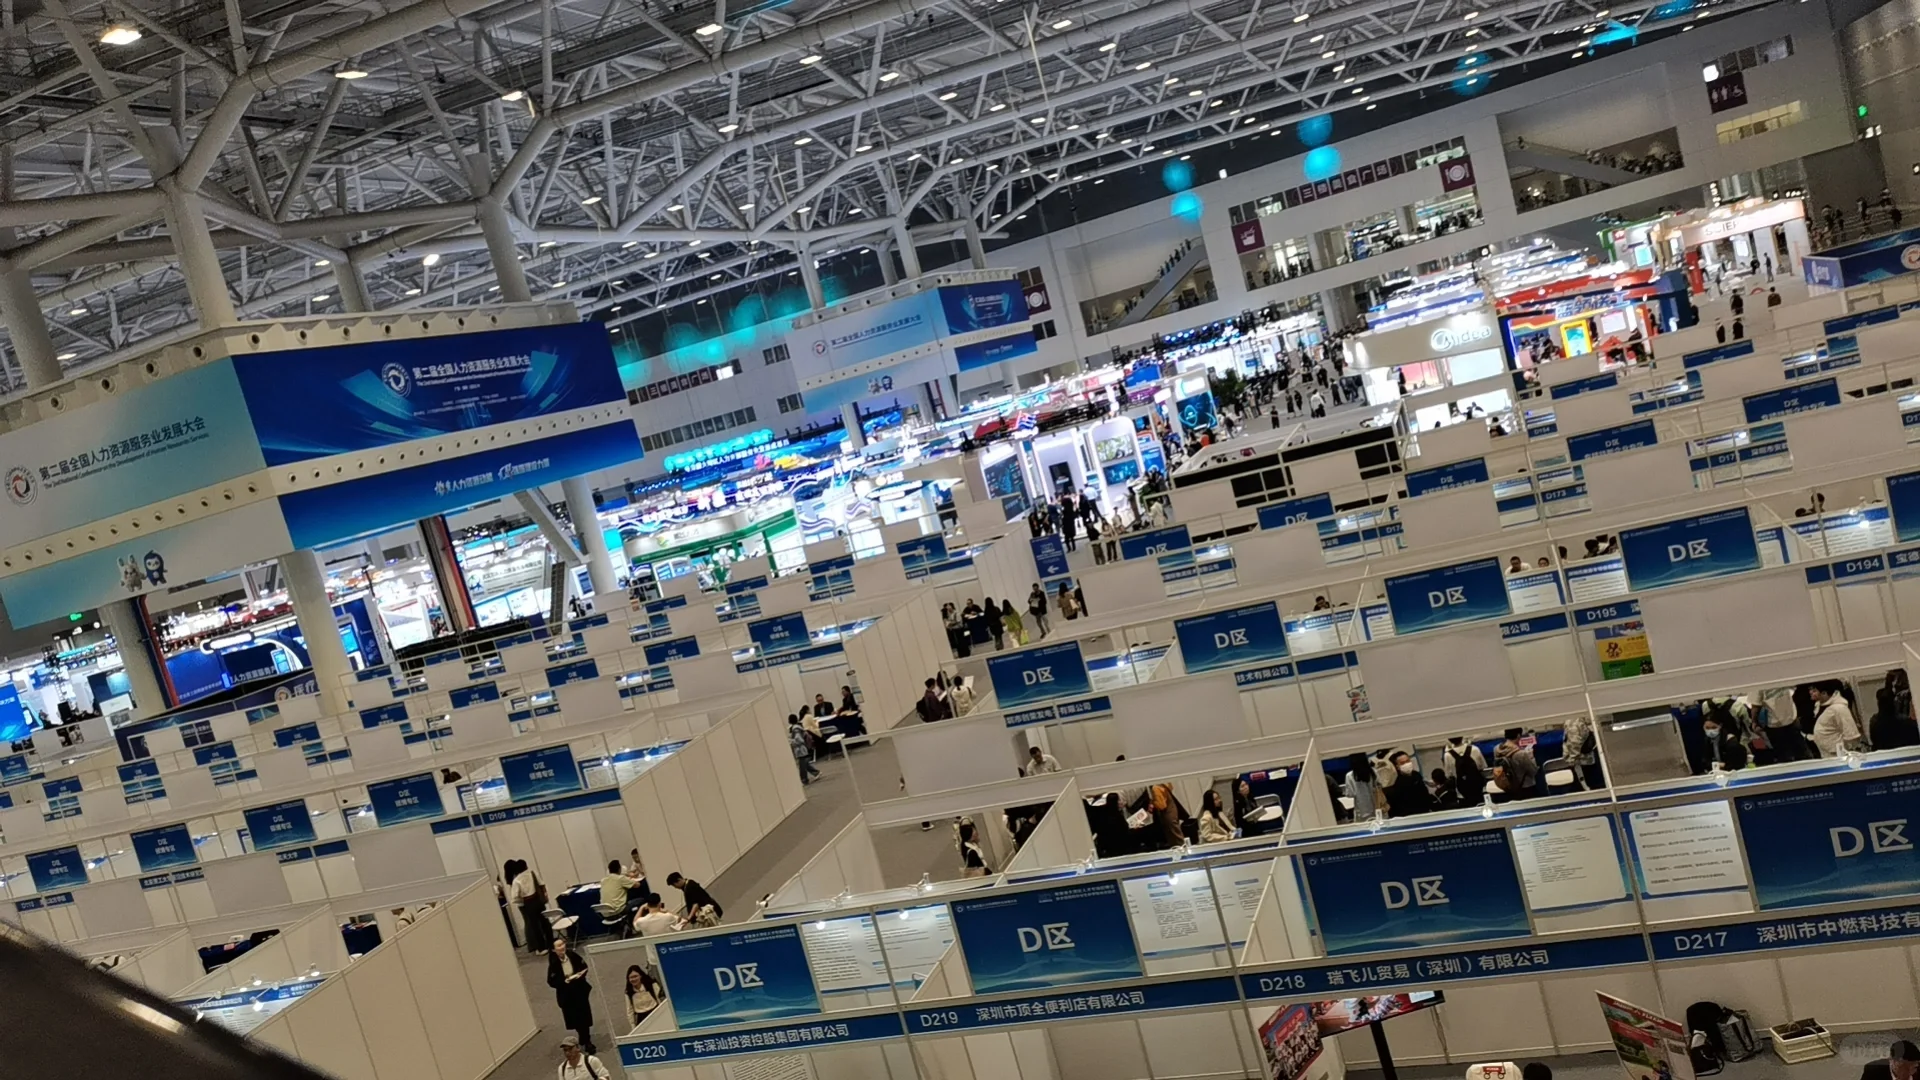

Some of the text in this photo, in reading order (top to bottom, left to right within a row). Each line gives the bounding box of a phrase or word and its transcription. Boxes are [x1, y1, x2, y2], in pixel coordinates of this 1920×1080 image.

[412, 354, 532, 380] 第二届全国人力资源服务业发展大会
[38, 415, 206, 481] 第二届全国人力资源服务业发展大会
[1667, 538, 1711, 563] D区
[1845, 557, 1880, 573] D194
[1428, 586, 1468, 609] D区
[1586, 607, 1618, 621] D195
[1213, 628, 1250, 649] D区
[1022, 666, 1055, 687] D区
[513, 802, 555, 817] 内蒙古师范大学
[1828, 818, 1914, 859] D区
[1381, 875, 1450, 911] D区
[1017, 922, 1075, 953] D区
[1674, 931, 1728, 952] D217
[713, 962, 764, 992] D区
[1259, 974, 1306, 993] D218
[919, 990, 1145, 1028] D219 深圳市顶全便利店有限公司
[633, 1023, 849, 1060] D220 广东深汕投资控股集团有限公司
